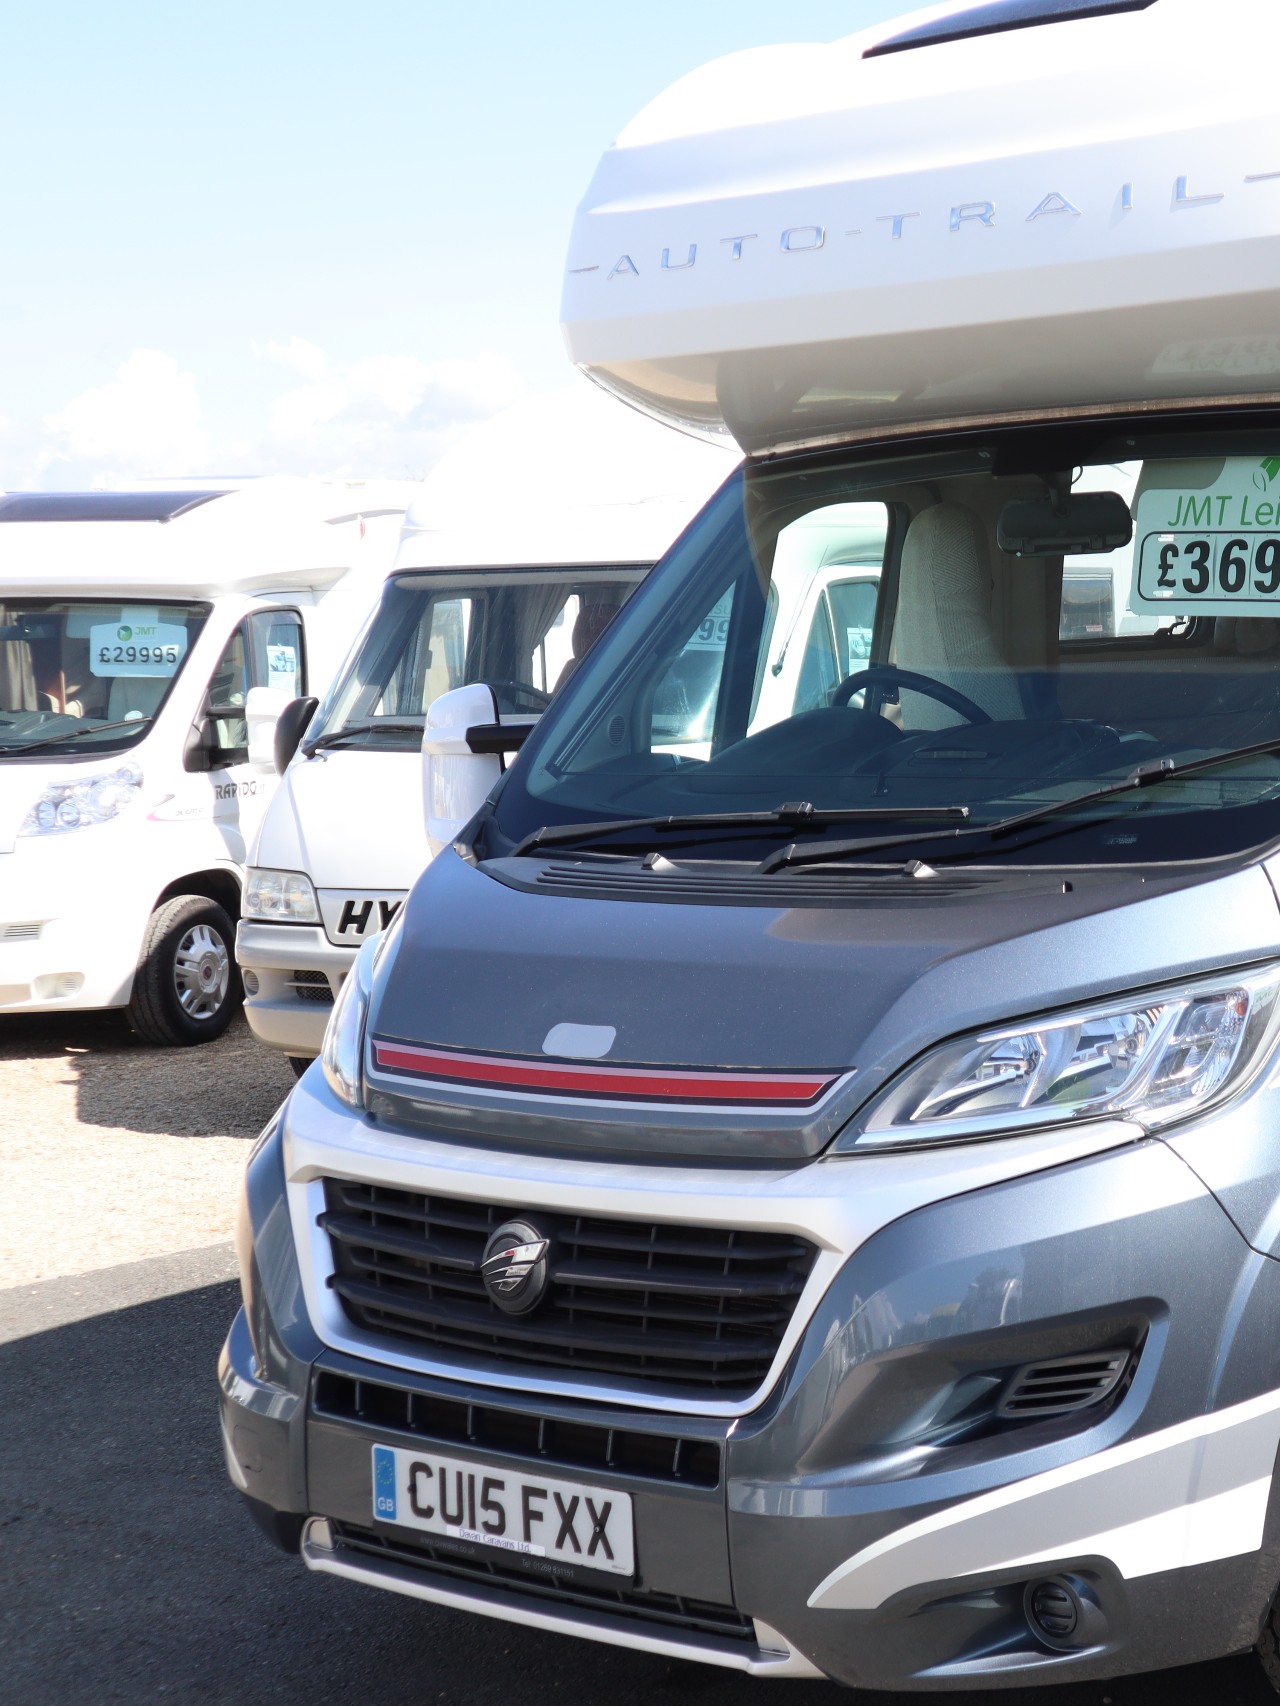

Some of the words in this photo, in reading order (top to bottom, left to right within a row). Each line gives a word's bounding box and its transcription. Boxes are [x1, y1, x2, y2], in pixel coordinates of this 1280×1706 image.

[606, 173, 1225, 281] AUTO-TRAIL
[1167, 494, 1233, 527] JMT
[134, 626, 158, 636] JMT
[98, 646, 177, 664] £29995
[376, 1496, 395, 1513] GB
[407, 1460, 507, 1537] CU15
[521, 1484, 615, 1561] FXX
[483, 1534, 515, 1549] Caravans
